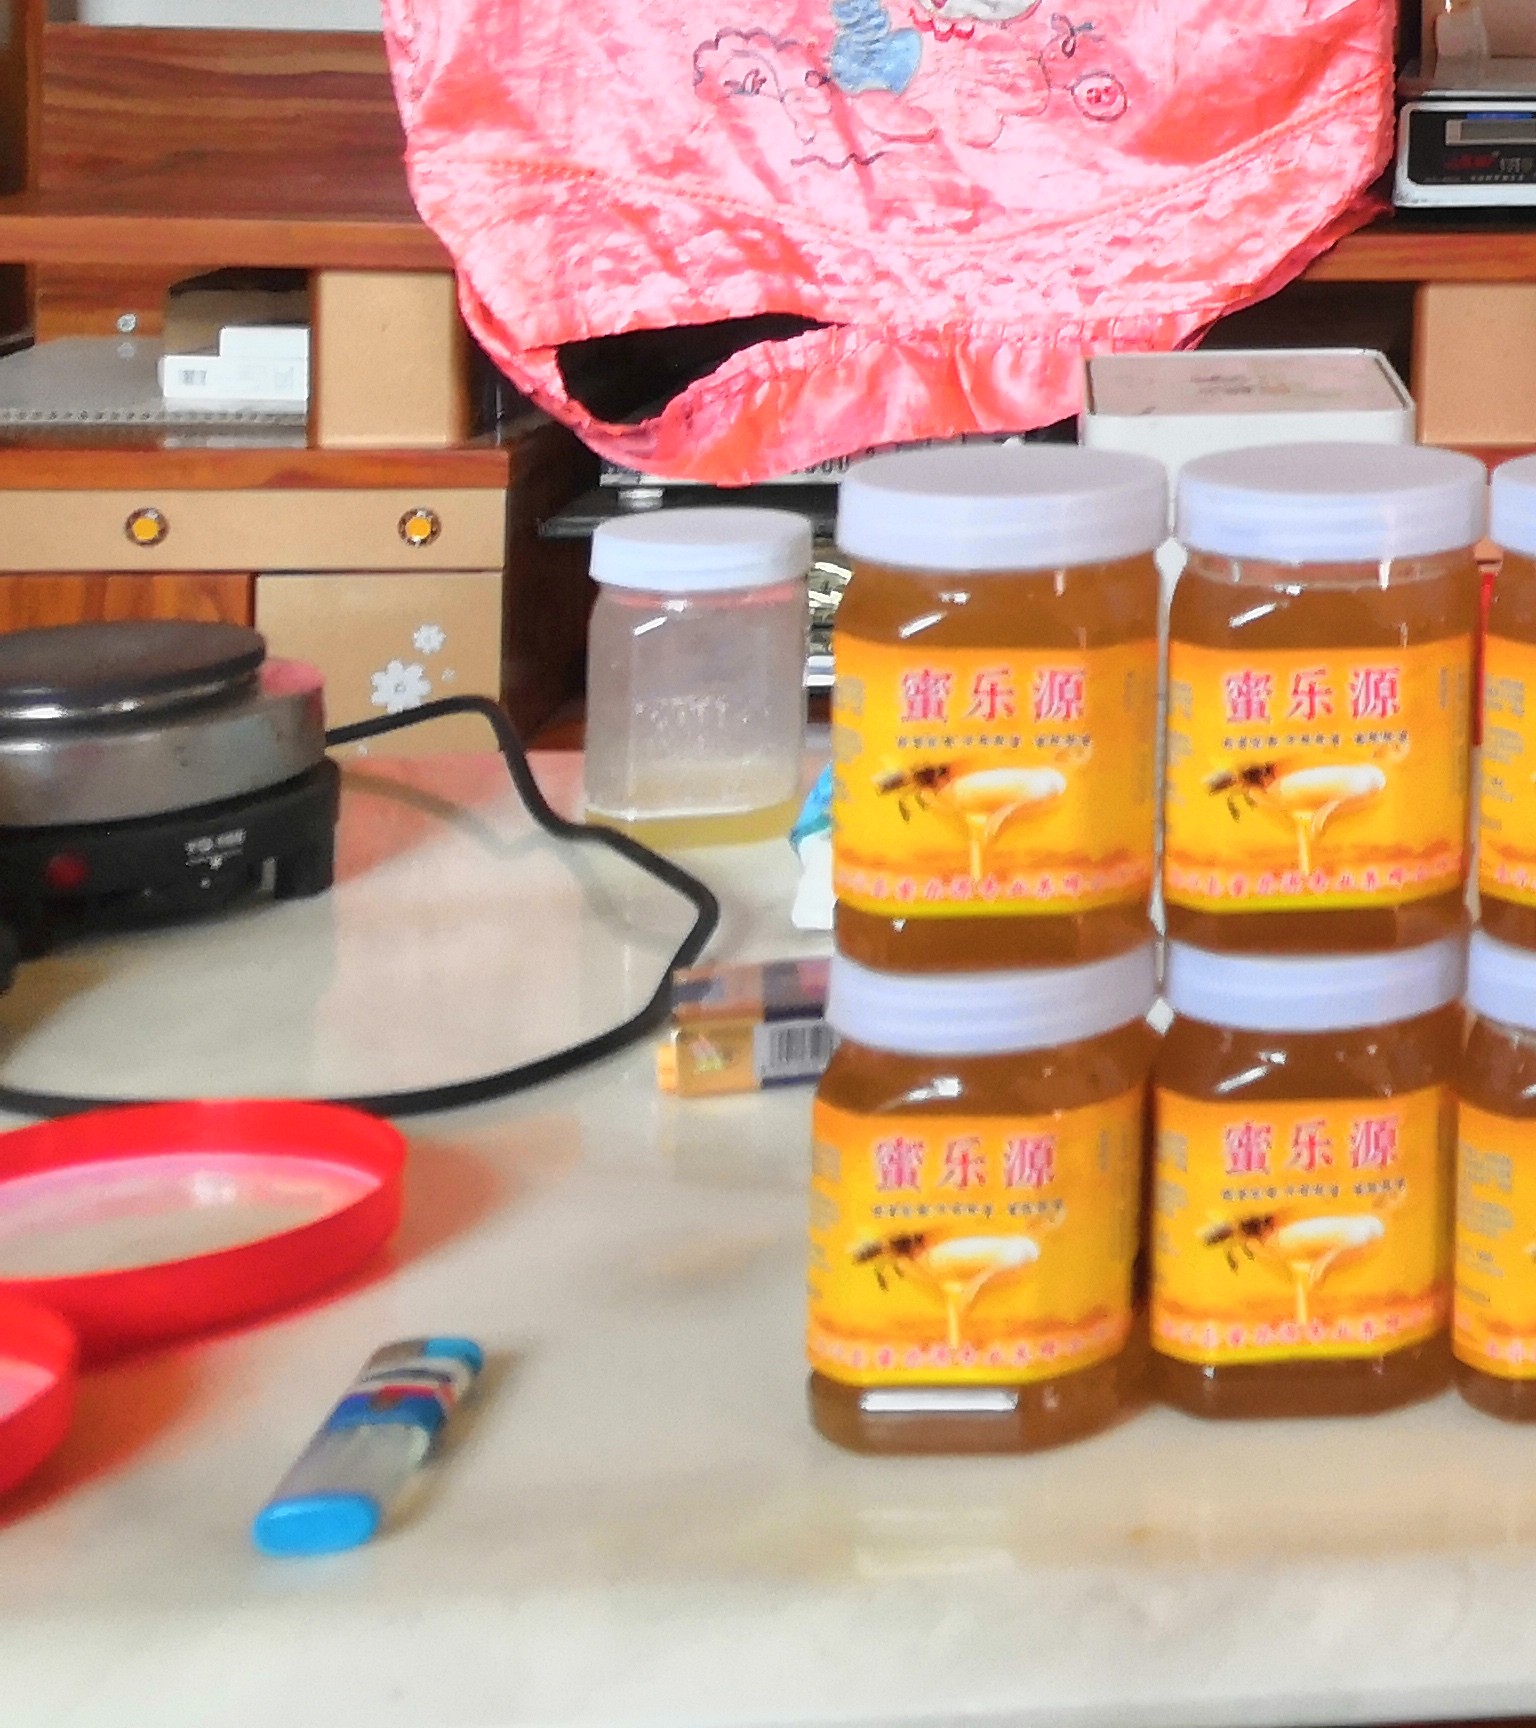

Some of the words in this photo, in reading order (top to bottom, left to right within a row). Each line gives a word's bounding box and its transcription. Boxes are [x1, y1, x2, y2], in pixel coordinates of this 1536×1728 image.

[900, 668, 1085, 722] 蜜乐源
[1226, 668, 1399, 722] 蜜乐源
[875, 1133, 1057, 1191] 蜜乐源
[1223, 1114, 1400, 1175] 蜜乐源
